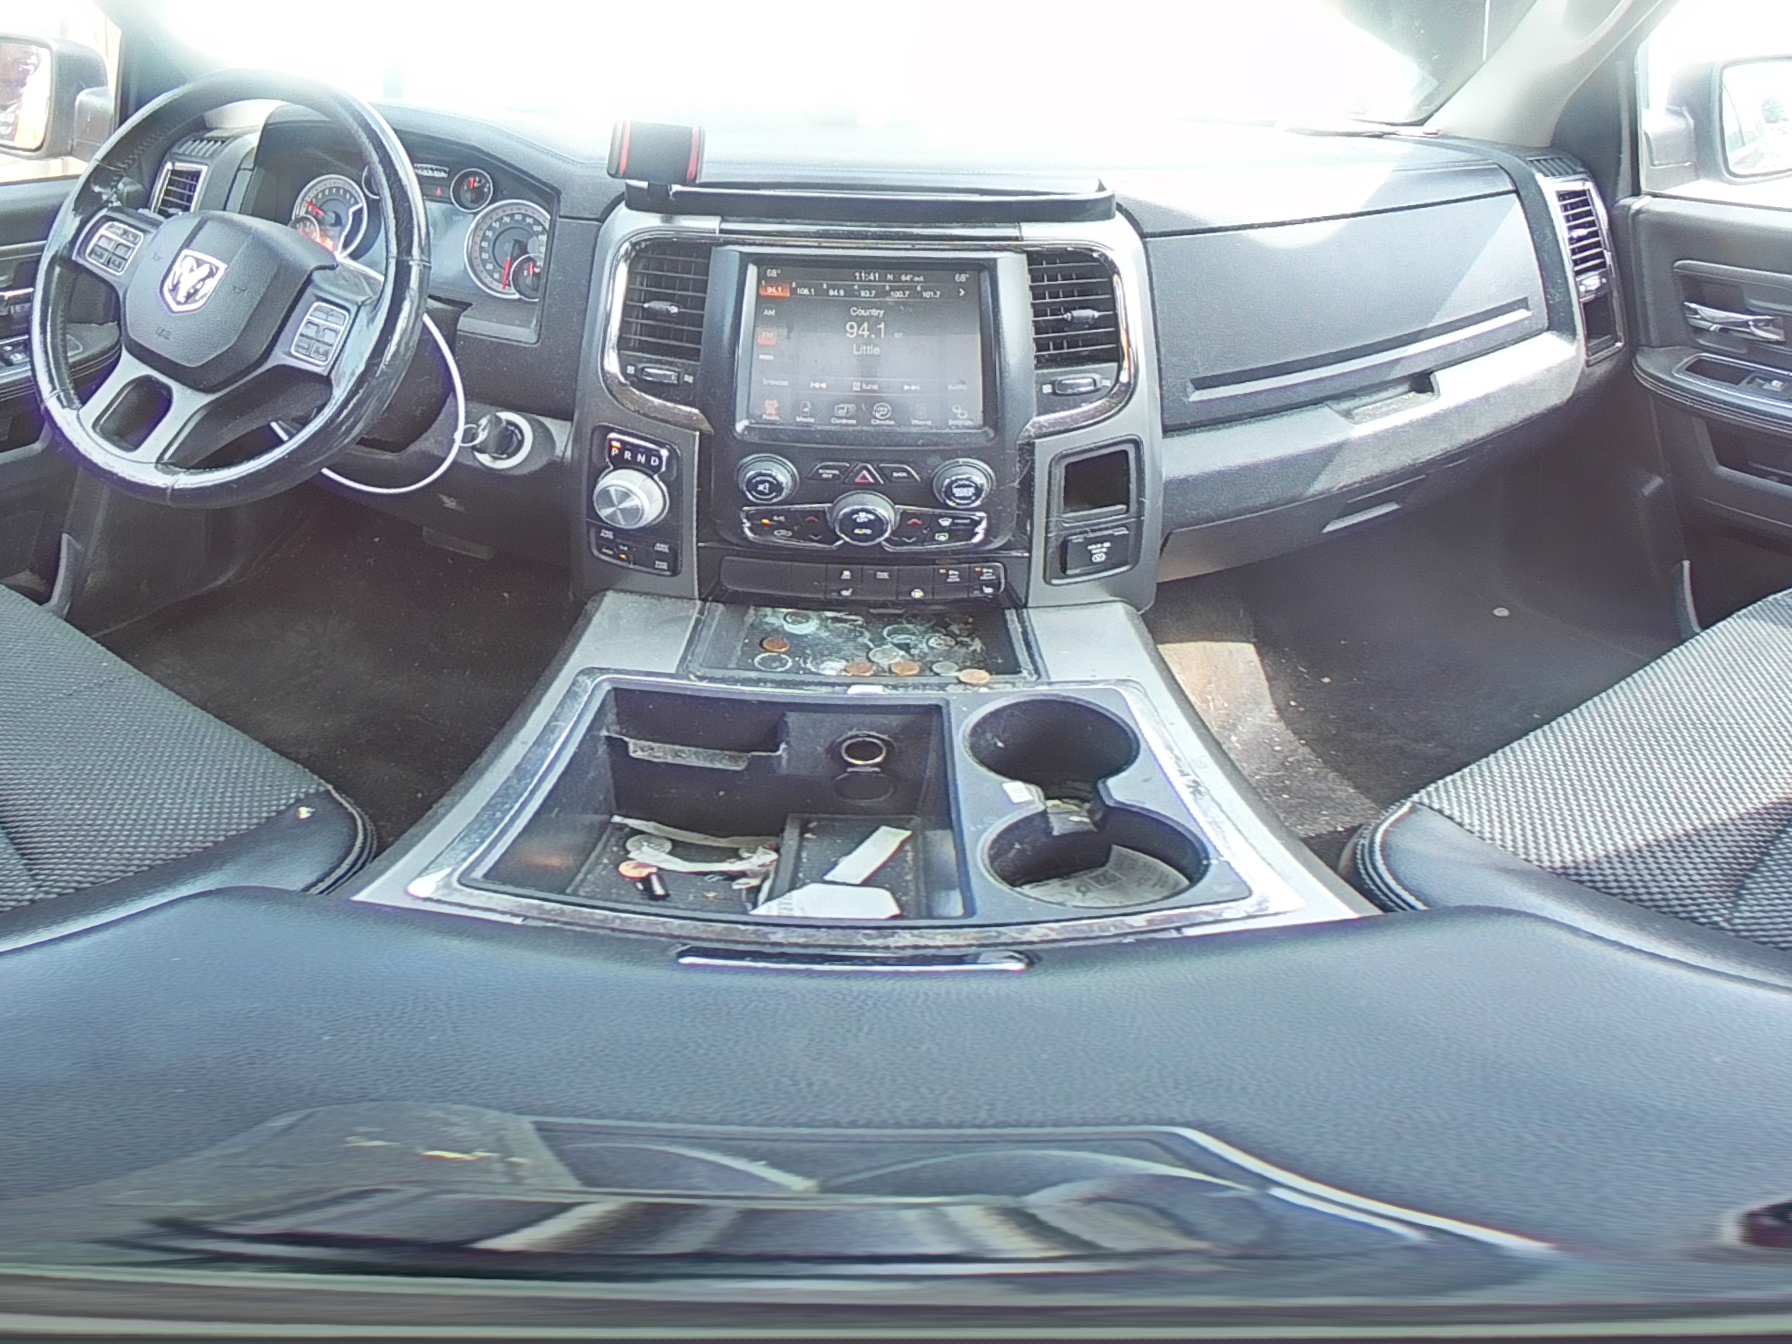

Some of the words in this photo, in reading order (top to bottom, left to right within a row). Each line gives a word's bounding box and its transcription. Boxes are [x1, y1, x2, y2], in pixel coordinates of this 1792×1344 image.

[854, 270, 879, 282] 11:41
[762, 308, 776, 317] AM
[849, 306, 886, 319] Country
[845, 321, 887, 339] 94.1
[852, 343, 882, 356] Little
[623, 450, 632, 461] R
[637, 452, 646, 464] N
[650, 455, 660, 467] D
